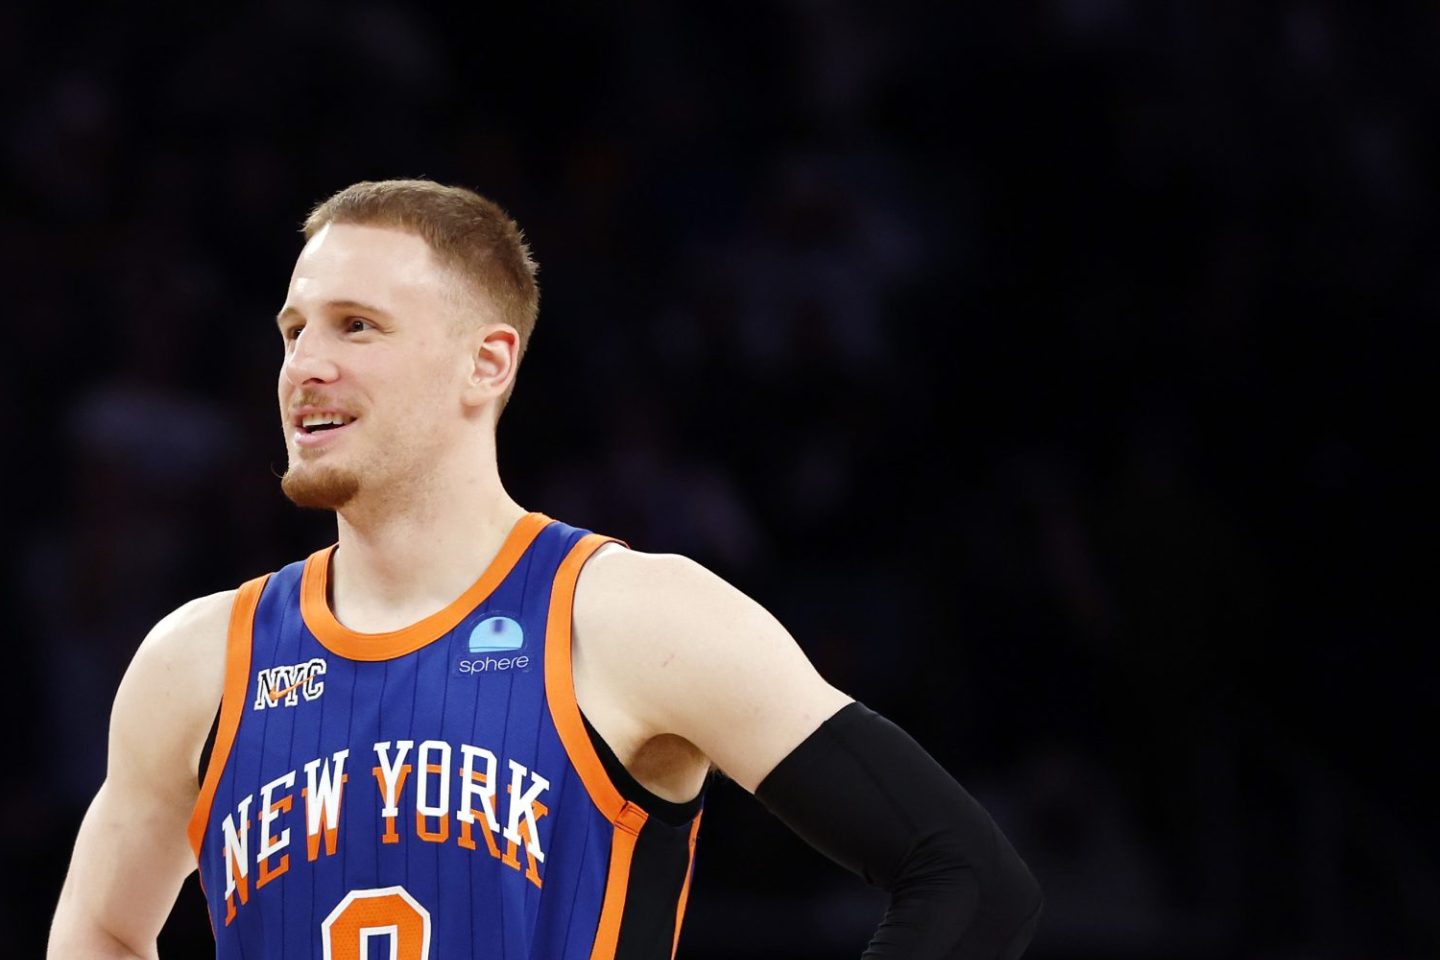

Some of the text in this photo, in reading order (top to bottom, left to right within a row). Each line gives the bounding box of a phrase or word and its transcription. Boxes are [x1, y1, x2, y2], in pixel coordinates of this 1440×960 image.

[254, 658, 327, 711] NYC
[459, 653, 529, 675] sphere
[222, 740, 550, 926] NEW YORK
